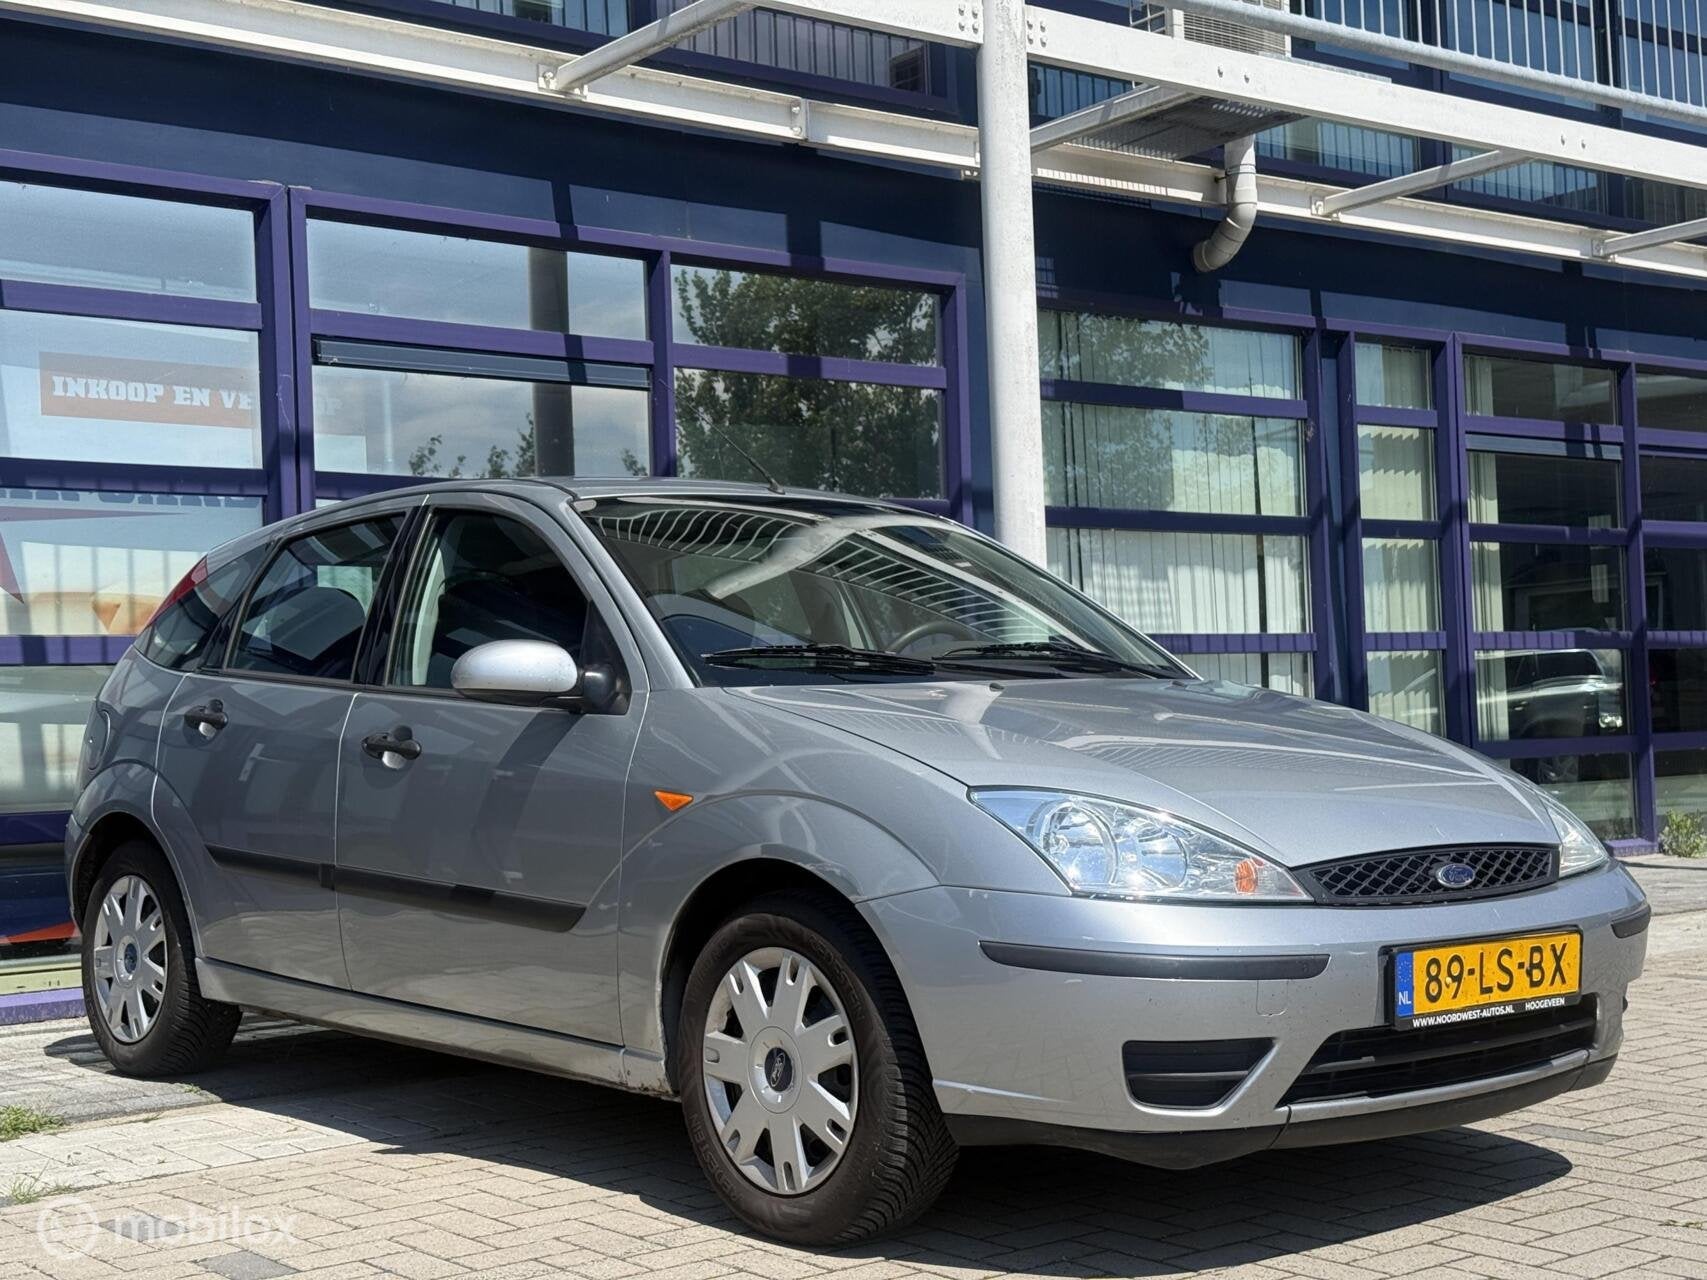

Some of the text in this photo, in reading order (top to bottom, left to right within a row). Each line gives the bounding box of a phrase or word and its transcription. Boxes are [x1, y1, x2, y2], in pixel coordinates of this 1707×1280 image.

[52, 375, 164, 404] INKOOP
[173, 385, 211, 407] EN
[1424, 942, 1568, 1003] 89-LS-BX
[1398, 991, 1412, 1005] NL
[1412, 997, 1566, 1028] WWW.NOORDWEST-AUTOS.NL HOOGEVEEN
